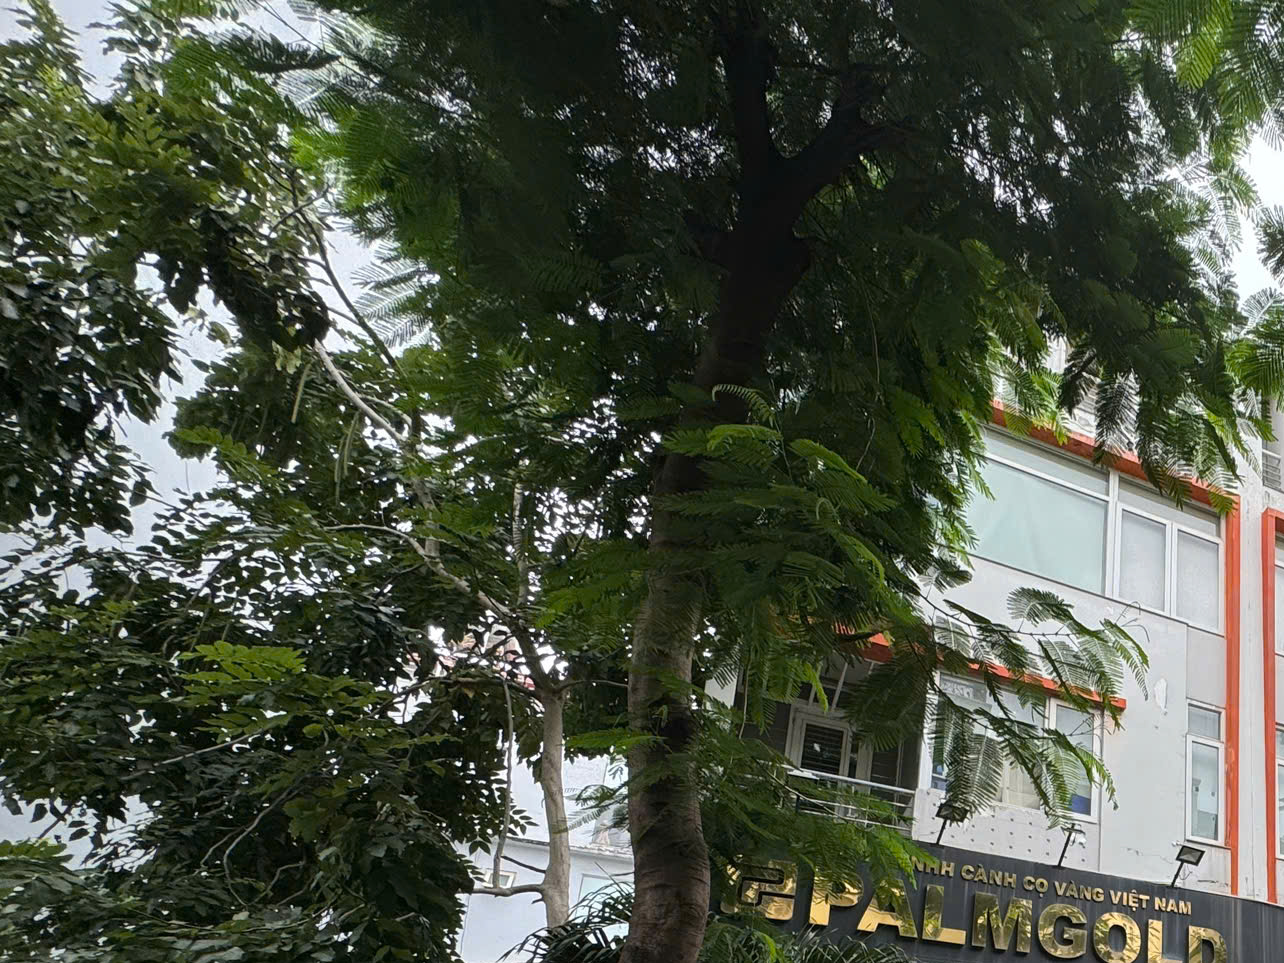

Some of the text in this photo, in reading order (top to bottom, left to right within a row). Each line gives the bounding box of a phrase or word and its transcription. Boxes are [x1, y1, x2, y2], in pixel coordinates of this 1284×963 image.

[911, 856, 1192, 915] NHH CÀNH CỌ VÀNG VIỆT NAM
